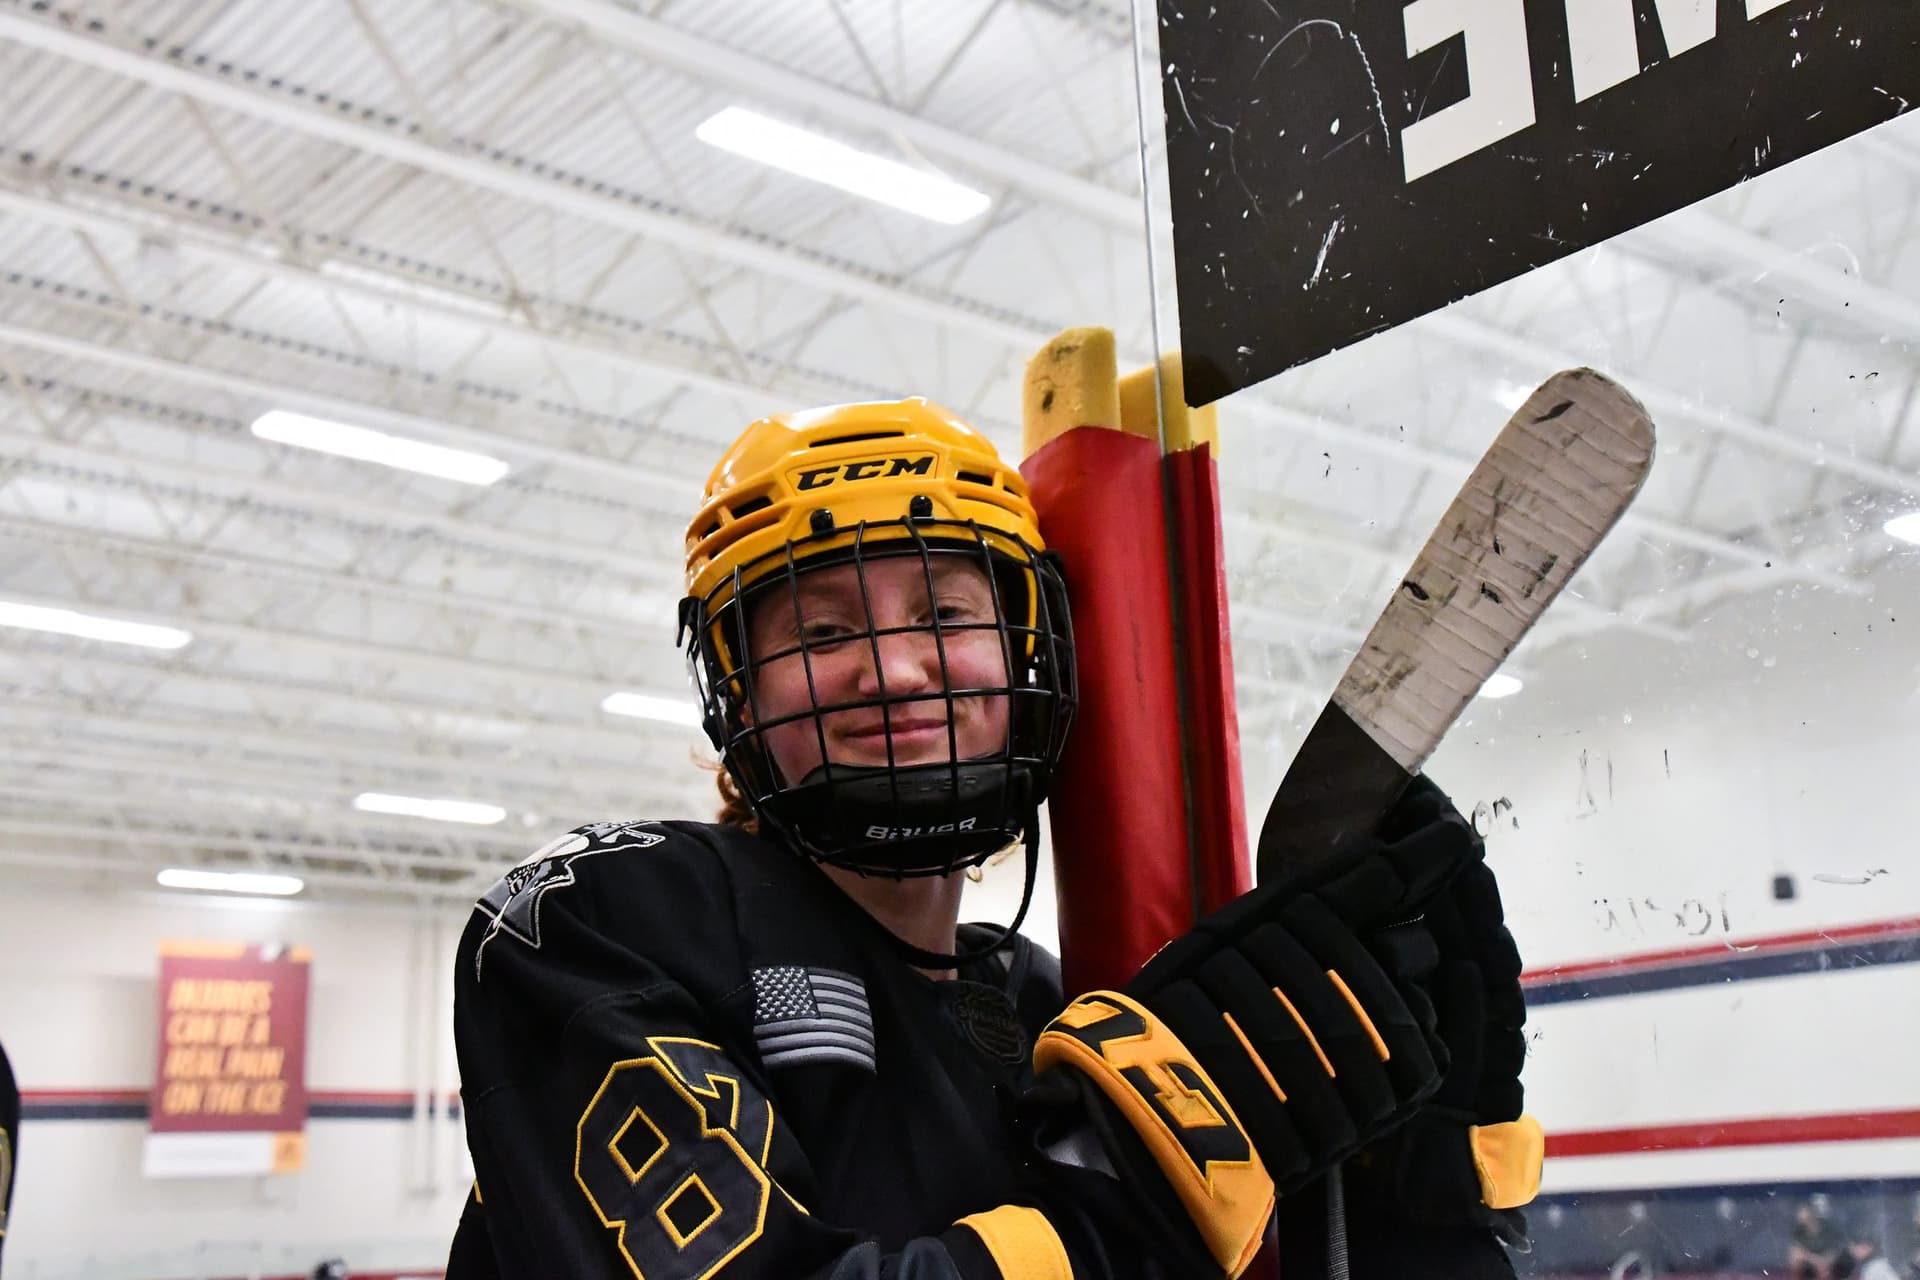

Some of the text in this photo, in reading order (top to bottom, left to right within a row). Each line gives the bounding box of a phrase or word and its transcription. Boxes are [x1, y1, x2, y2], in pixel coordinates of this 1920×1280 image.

[796, 456, 934, 491] CCM
[865, 816, 977, 840] BAUER
[167, 980, 273, 1010] INJURIES
[166, 1012, 271, 1045] CAN BE A
[164, 1046, 285, 1078] REAL PAIN
[162, 1080, 288, 1115] ON THE ICE
[1043, 994, 1253, 1199] CC
